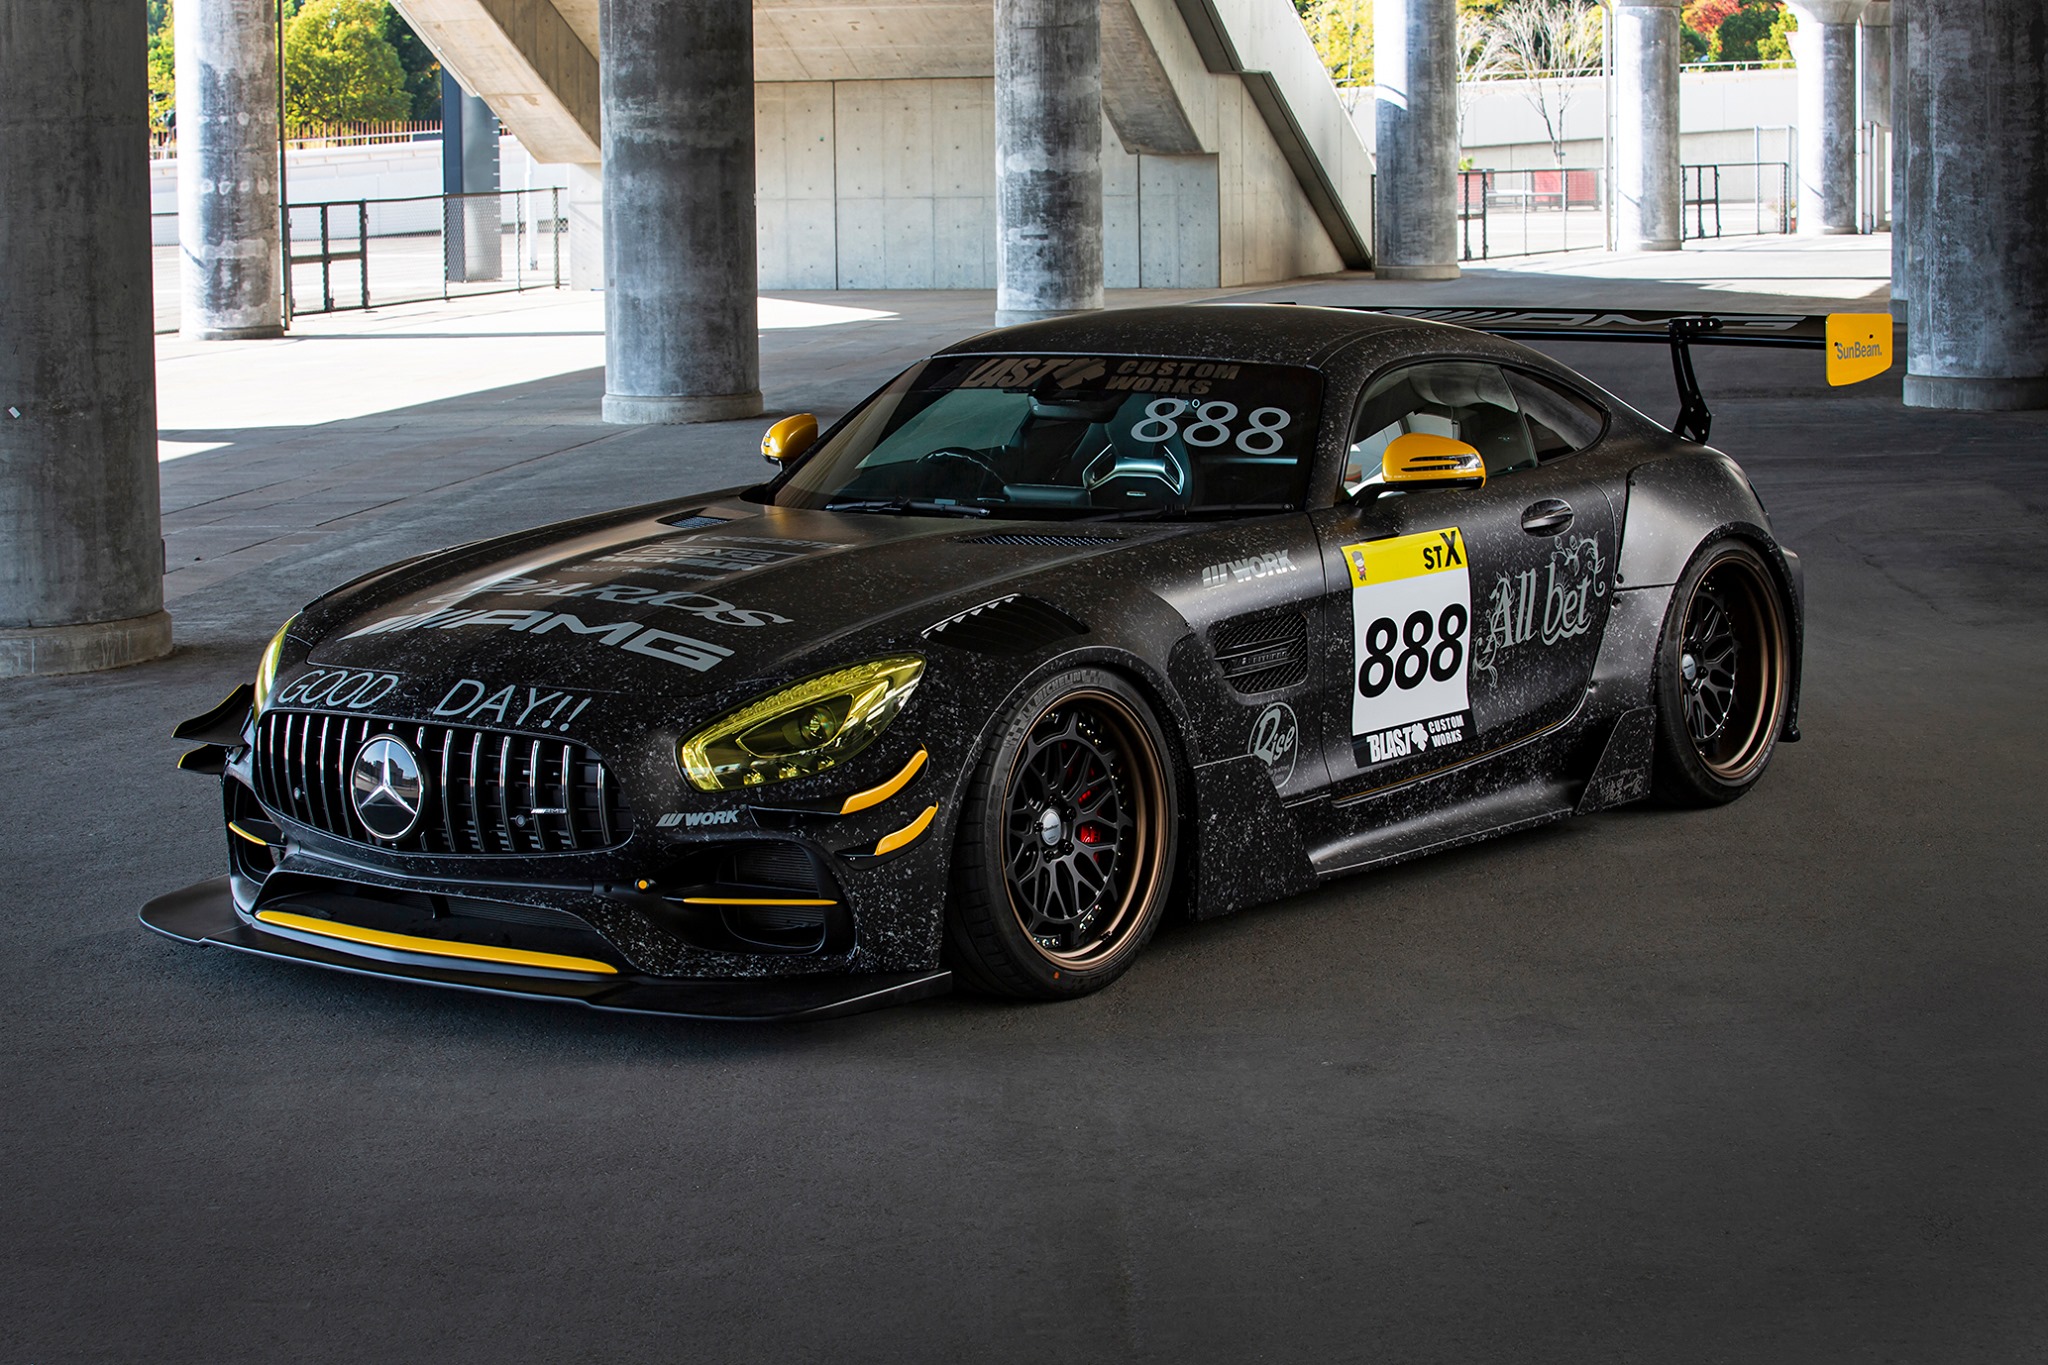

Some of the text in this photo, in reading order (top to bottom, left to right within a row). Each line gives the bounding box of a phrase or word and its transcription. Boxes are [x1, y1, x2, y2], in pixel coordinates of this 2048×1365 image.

[1104, 375, 1213, 395] WORKS
[1116, 360, 1241, 380] CUSTOM
[1130, 398, 1291, 455] 888
[1227, 549, 1297, 583] WORK
[1481, 561, 1593, 656] All bet
[1358, 603, 1468, 699] 888
[278, 669, 592, 732] GOOD DAY!!
[1033, 671, 1081, 706] MICHELIN
[1366, 714, 1465, 763] BLAST CUSTOM
[1431, 729, 1463, 748] WORKS
[685, 809, 739, 827] WORK
